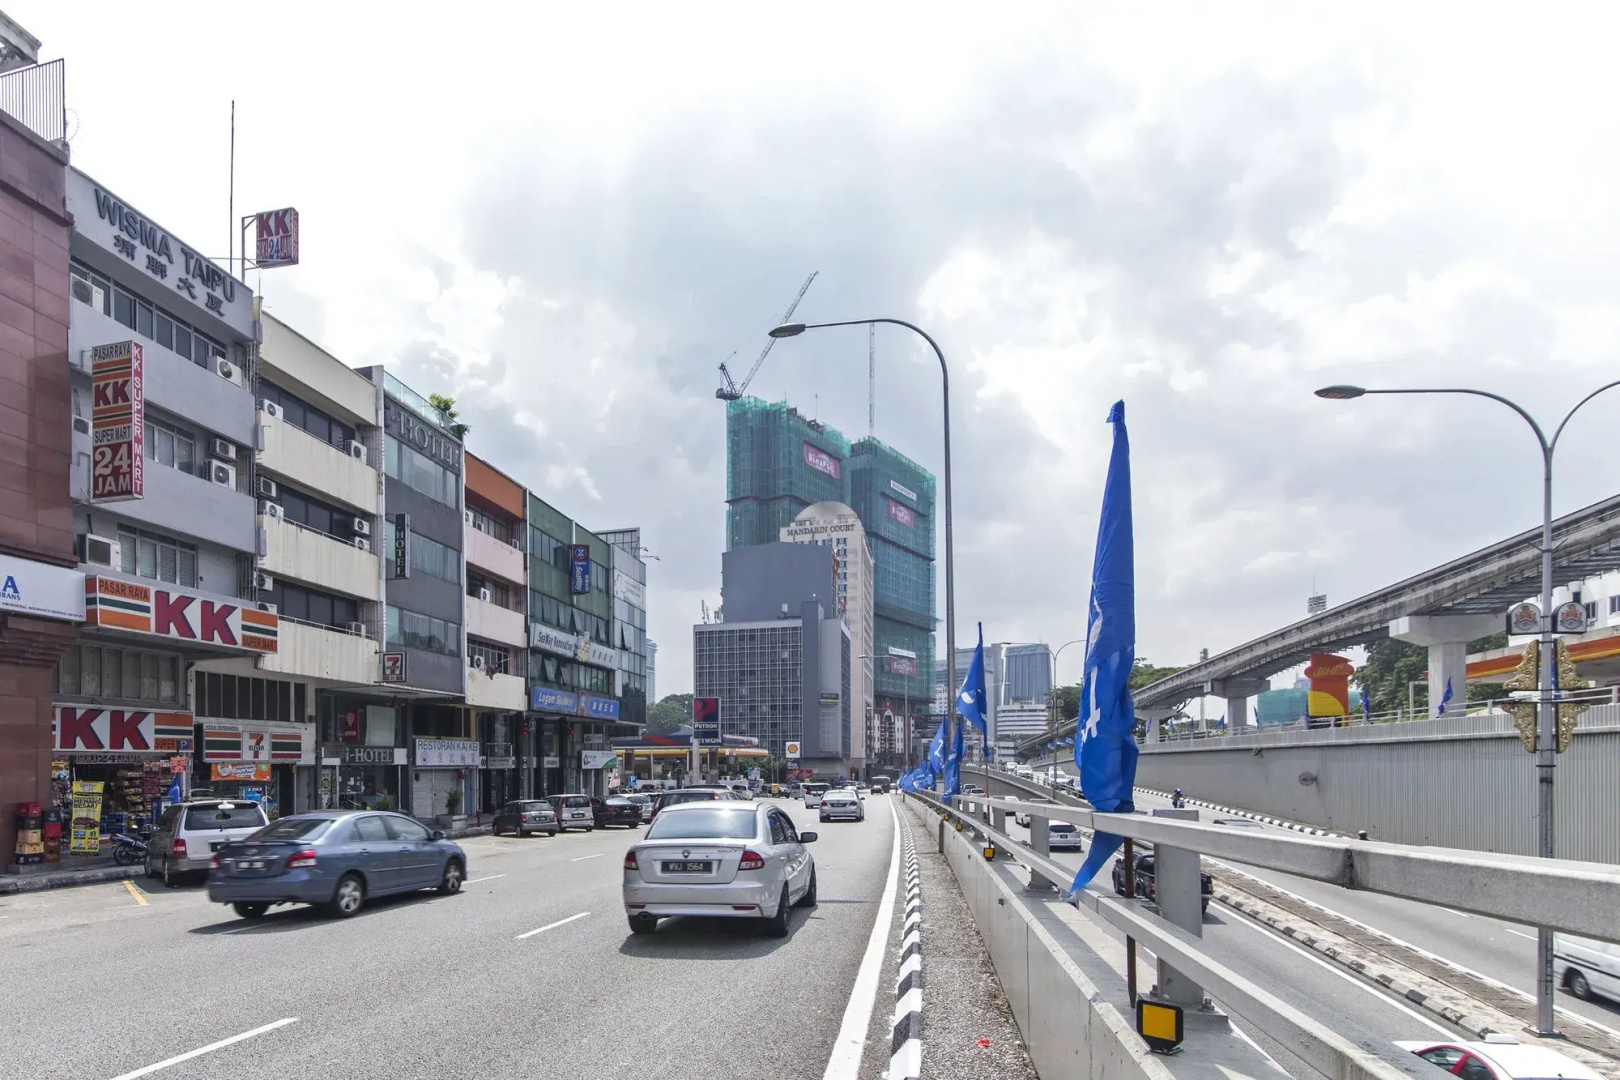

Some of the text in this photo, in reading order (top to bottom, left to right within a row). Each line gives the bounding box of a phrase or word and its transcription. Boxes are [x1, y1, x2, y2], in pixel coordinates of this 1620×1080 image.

[258, 209, 290, 239] KK
[94, 188, 235, 303] WISMA TAIPU
[268, 237, 279, 260] 24
[93, 342, 131, 363] PASAR RAYA
[94, 379, 130, 408] KK
[134, 347, 143, 492] KK SUPER MART
[94, 425, 131, 444] SUPER MART
[94, 444, 131, 476] 24
[95, 473, 131, 495] JAM
[786, 523, 856, 537] MANDARIN COURT
[99, 580, 149, 600] PASAR RAYA
[155, 590, 238, 646] KK
[242, 635, 278, 651] SUPER MART
[386, 656, 400, 676] 7
[60, 707, 150, 750] KK
[154, 739, 175, 749] SUPER
[180, 740, 188, 748] P
[249, 732, 264, 759] 7
[418, 740, 455, 750] RESTORAN
[456, 741, 468, 750] KAI
[98, 754, 117, 763] 24
[686, 862, 704, 871] 1564
